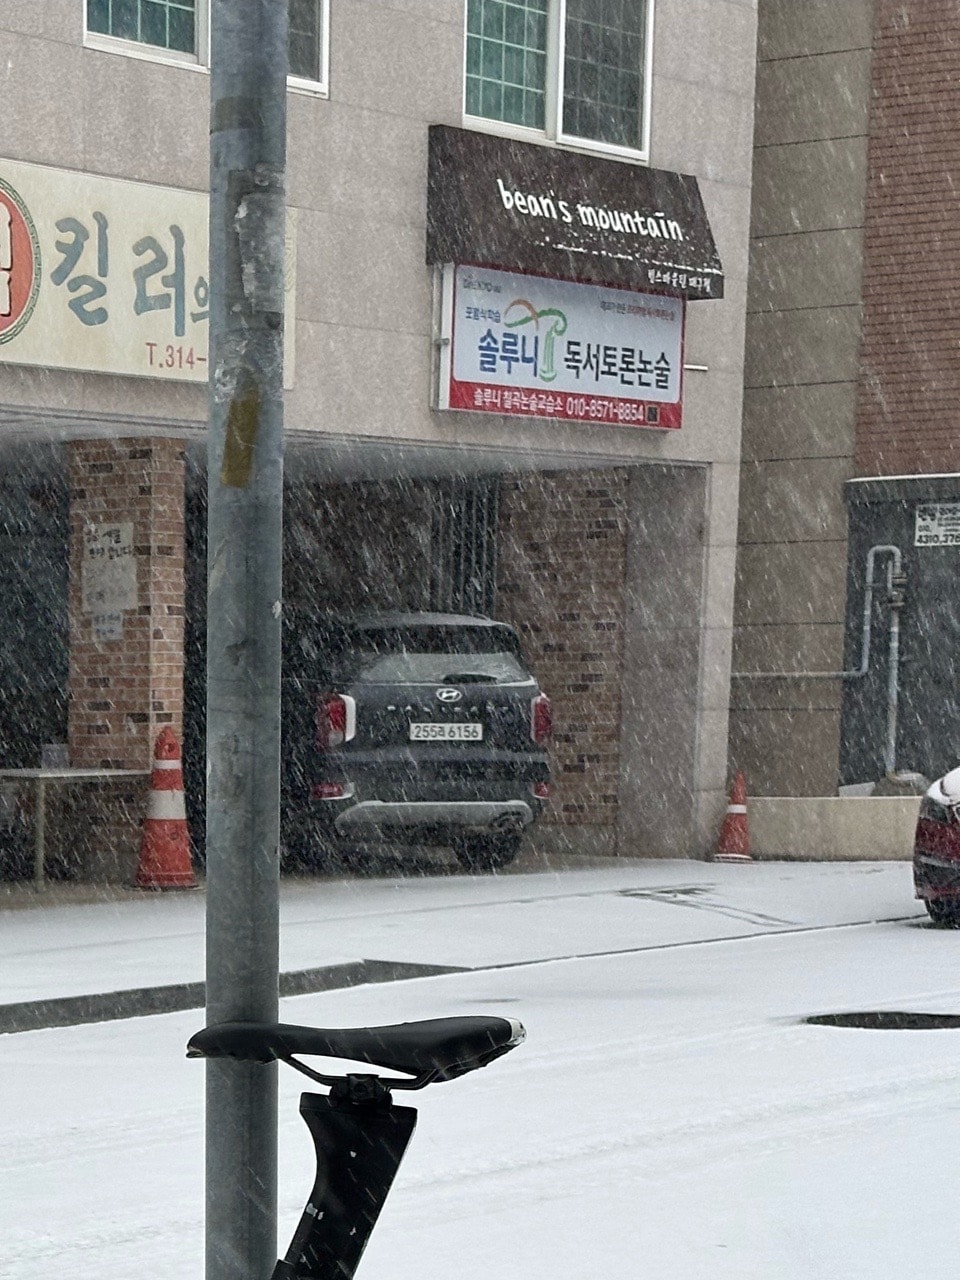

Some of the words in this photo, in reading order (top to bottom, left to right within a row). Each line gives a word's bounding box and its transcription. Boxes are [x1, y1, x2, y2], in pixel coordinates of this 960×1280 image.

[497, 179, 572, 224] bean's
[577, 203, 684, 242] mountain
[478, 328, 539, 377] 솔루니
[564, 340, 671, 390] 독서토론논술
[473, 387, 501, 408] 솔루니
[566, 396, 644, 421] 010-8571-8854
[448, 725, 479, 738] 6156
